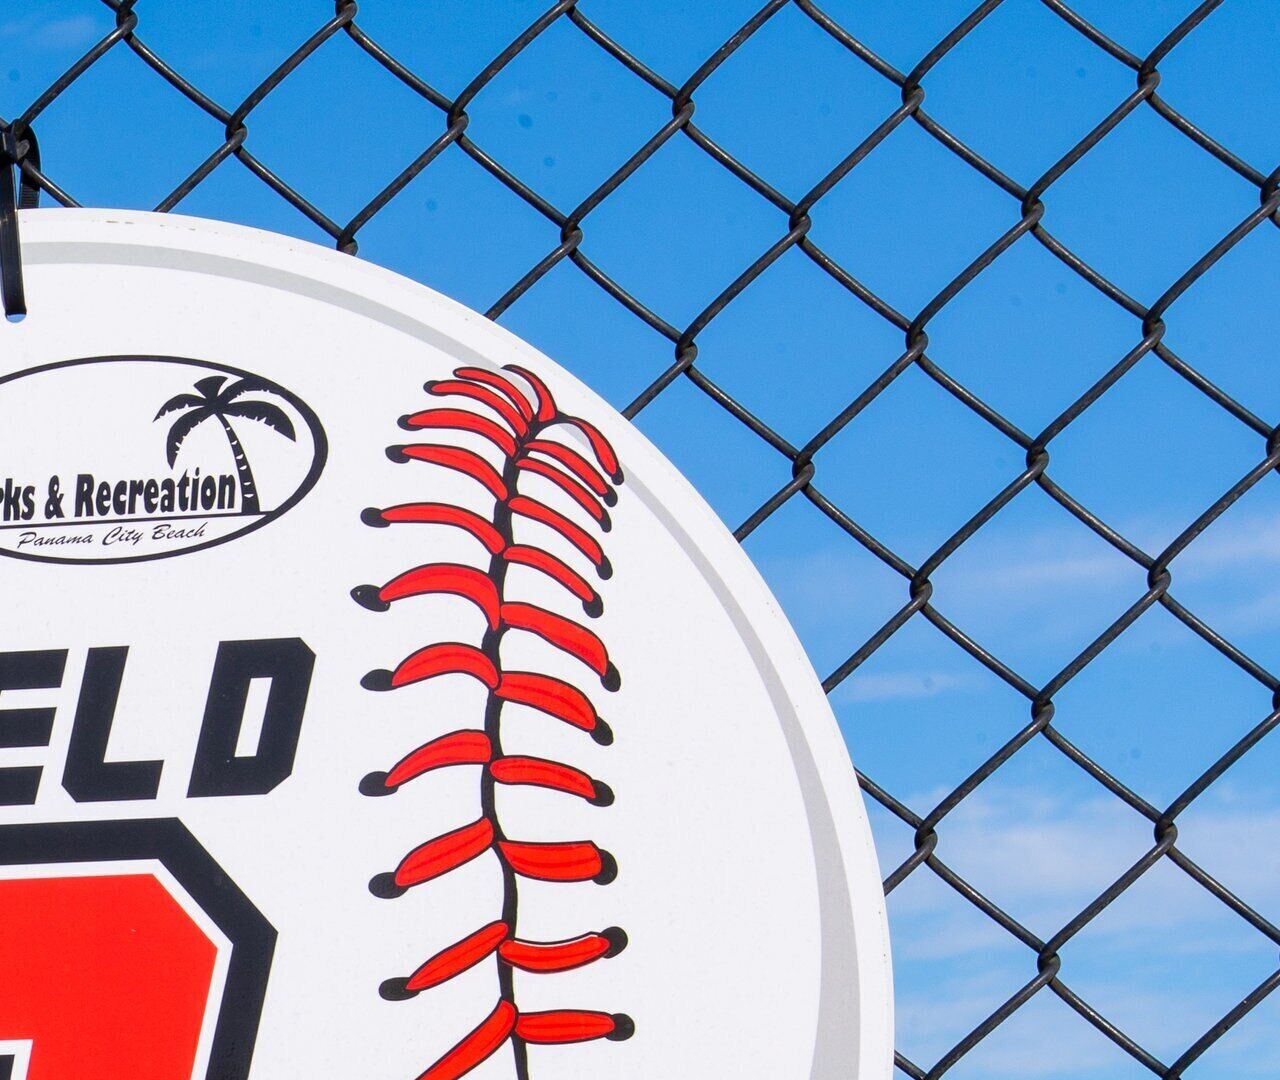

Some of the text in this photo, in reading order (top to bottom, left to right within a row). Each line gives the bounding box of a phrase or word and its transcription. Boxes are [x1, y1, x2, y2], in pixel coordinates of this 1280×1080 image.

[44, 474, 65, 520] &
[74, 466, 236, 518] Recreation
[16, 521, 209, 549] Panama City Beach
